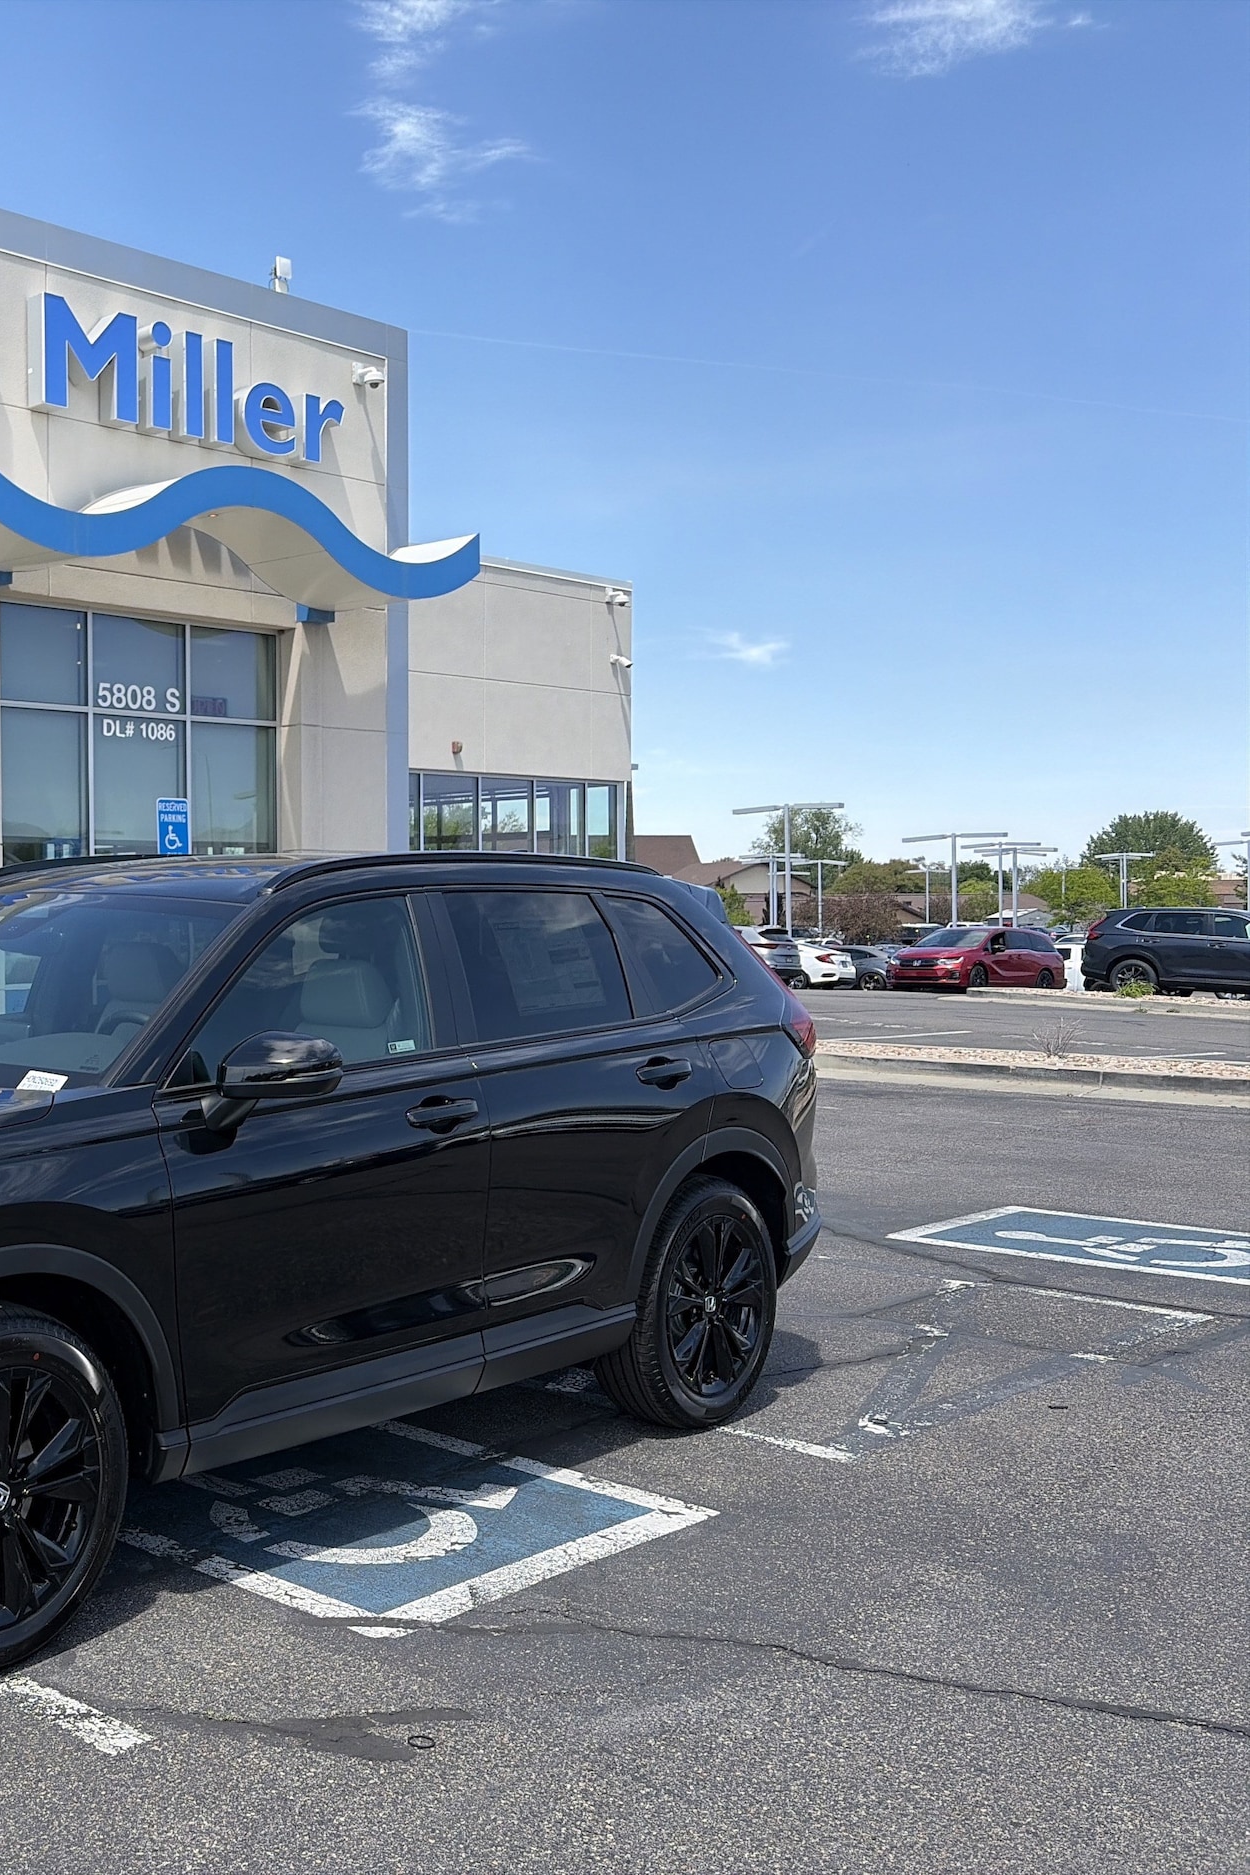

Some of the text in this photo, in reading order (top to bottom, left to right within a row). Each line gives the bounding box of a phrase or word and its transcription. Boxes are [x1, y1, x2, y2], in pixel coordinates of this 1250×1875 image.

[38, 291, 346, 464] Miller
[97, 682, 180, 713] 5808 S
[102, 718, 176, 741] DL# 1086
[158, 802, 187, 812] RESERVED
[160, 813, 186, 823] PARKING
